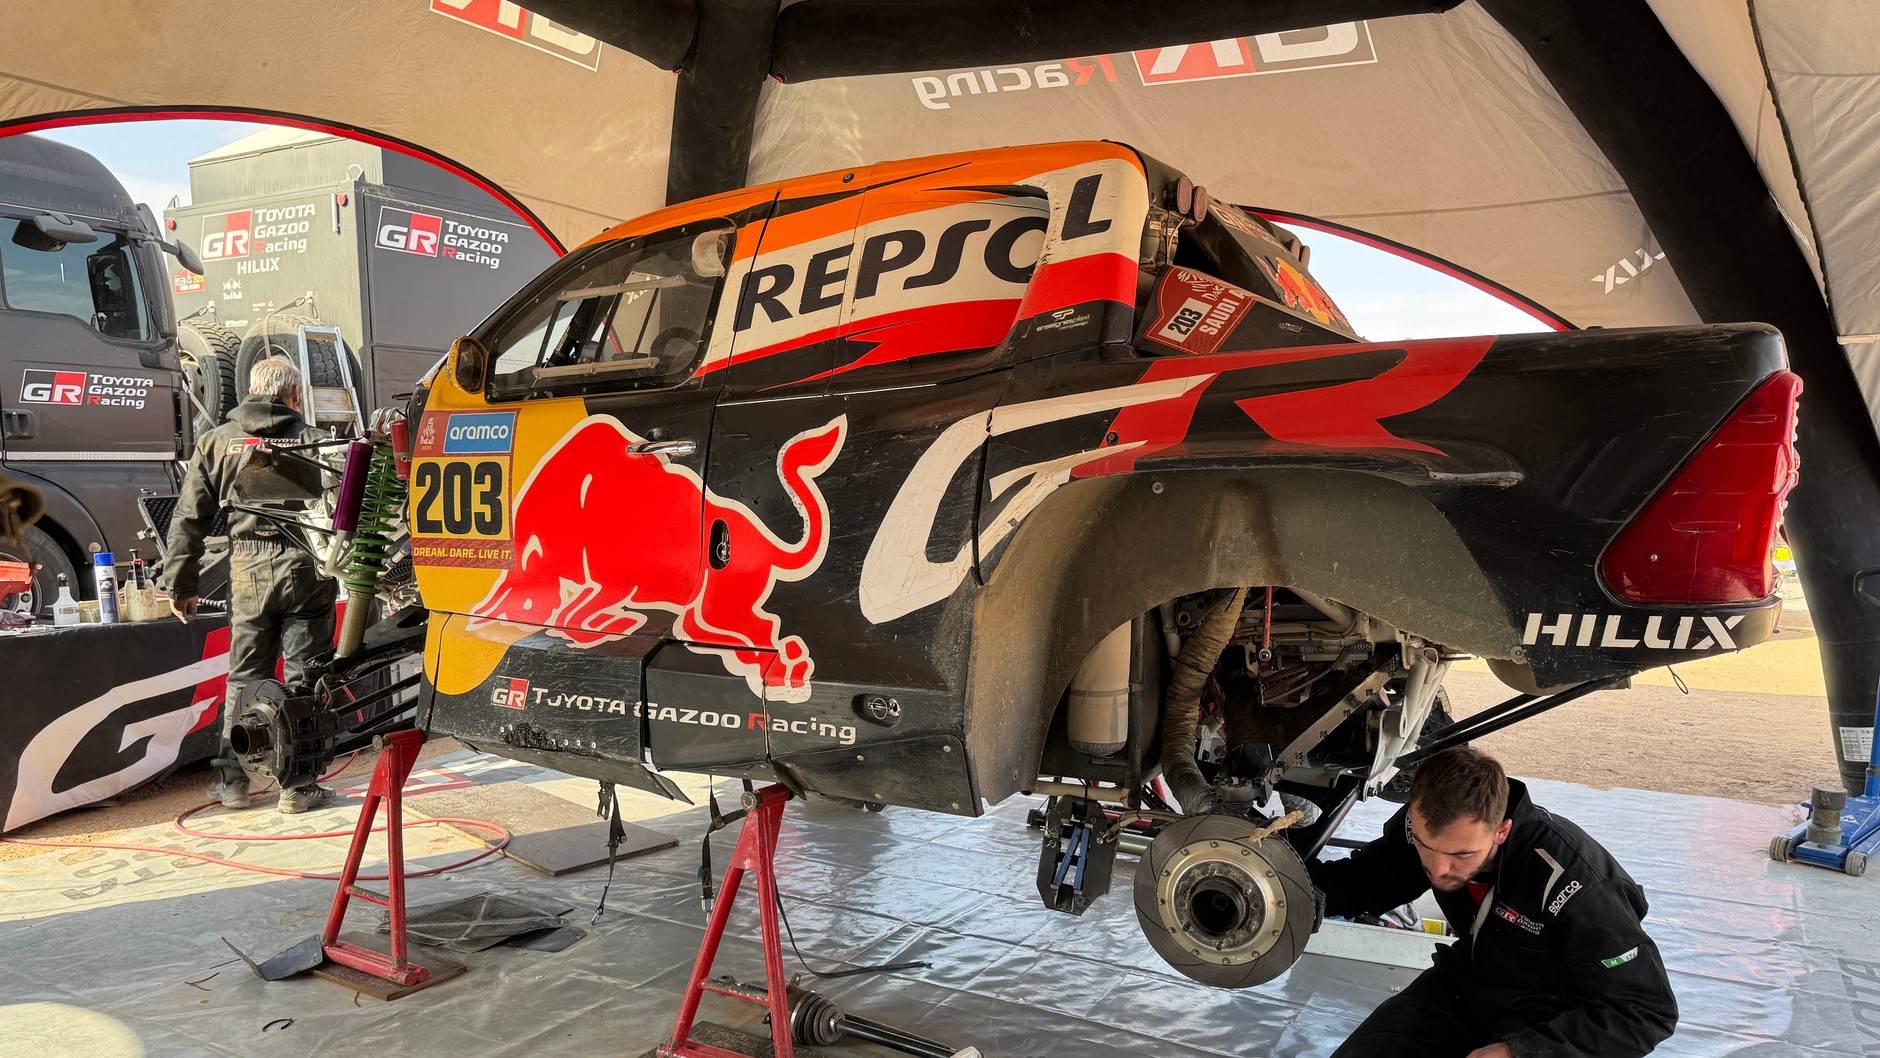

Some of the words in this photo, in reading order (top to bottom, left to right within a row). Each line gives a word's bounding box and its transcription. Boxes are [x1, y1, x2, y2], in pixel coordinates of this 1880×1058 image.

[254, 203, 316, 224] TOYOTA
[254, 221, 310, 239] GAZOO
[379, 224, 438, 254] GR
[445, 220, 509, 243] TOYOTA
[202, 229, 249, 259] GR
[253, 238, 308, 255] Racing
[443, 233, 503, 254] GAZOO
[733, 173, 1112, 332] REPSOL
[237, 257, 281, 275] HILUX
[441, 245, 500, 270] Racing
[1167, 307, 1203, 336] 203
[1199, 297, 1240, 336] SAUDI
[88, 385, 148, 397] GAZOO
[89, 374, 154, 387] TOYOTA
[23, 383, 82, 403] GR
[86, 395, 145, 409] Racing
[449, 424, 509, 440] aramco
[415, 461, 503, 535] 203
[413, 546, 448, 558] DREAM.
[449, 547, 477, 559] DARE.
[478, 549, 499, 560] LIVE
[500, 550, 512, 560] IT.
[1522, 612, 1746, 650] HILUX
[492, 687, 527, 708] GR
[746, 712, 858, 746] Racing
[1548, 880, 1583, 917] sparco
